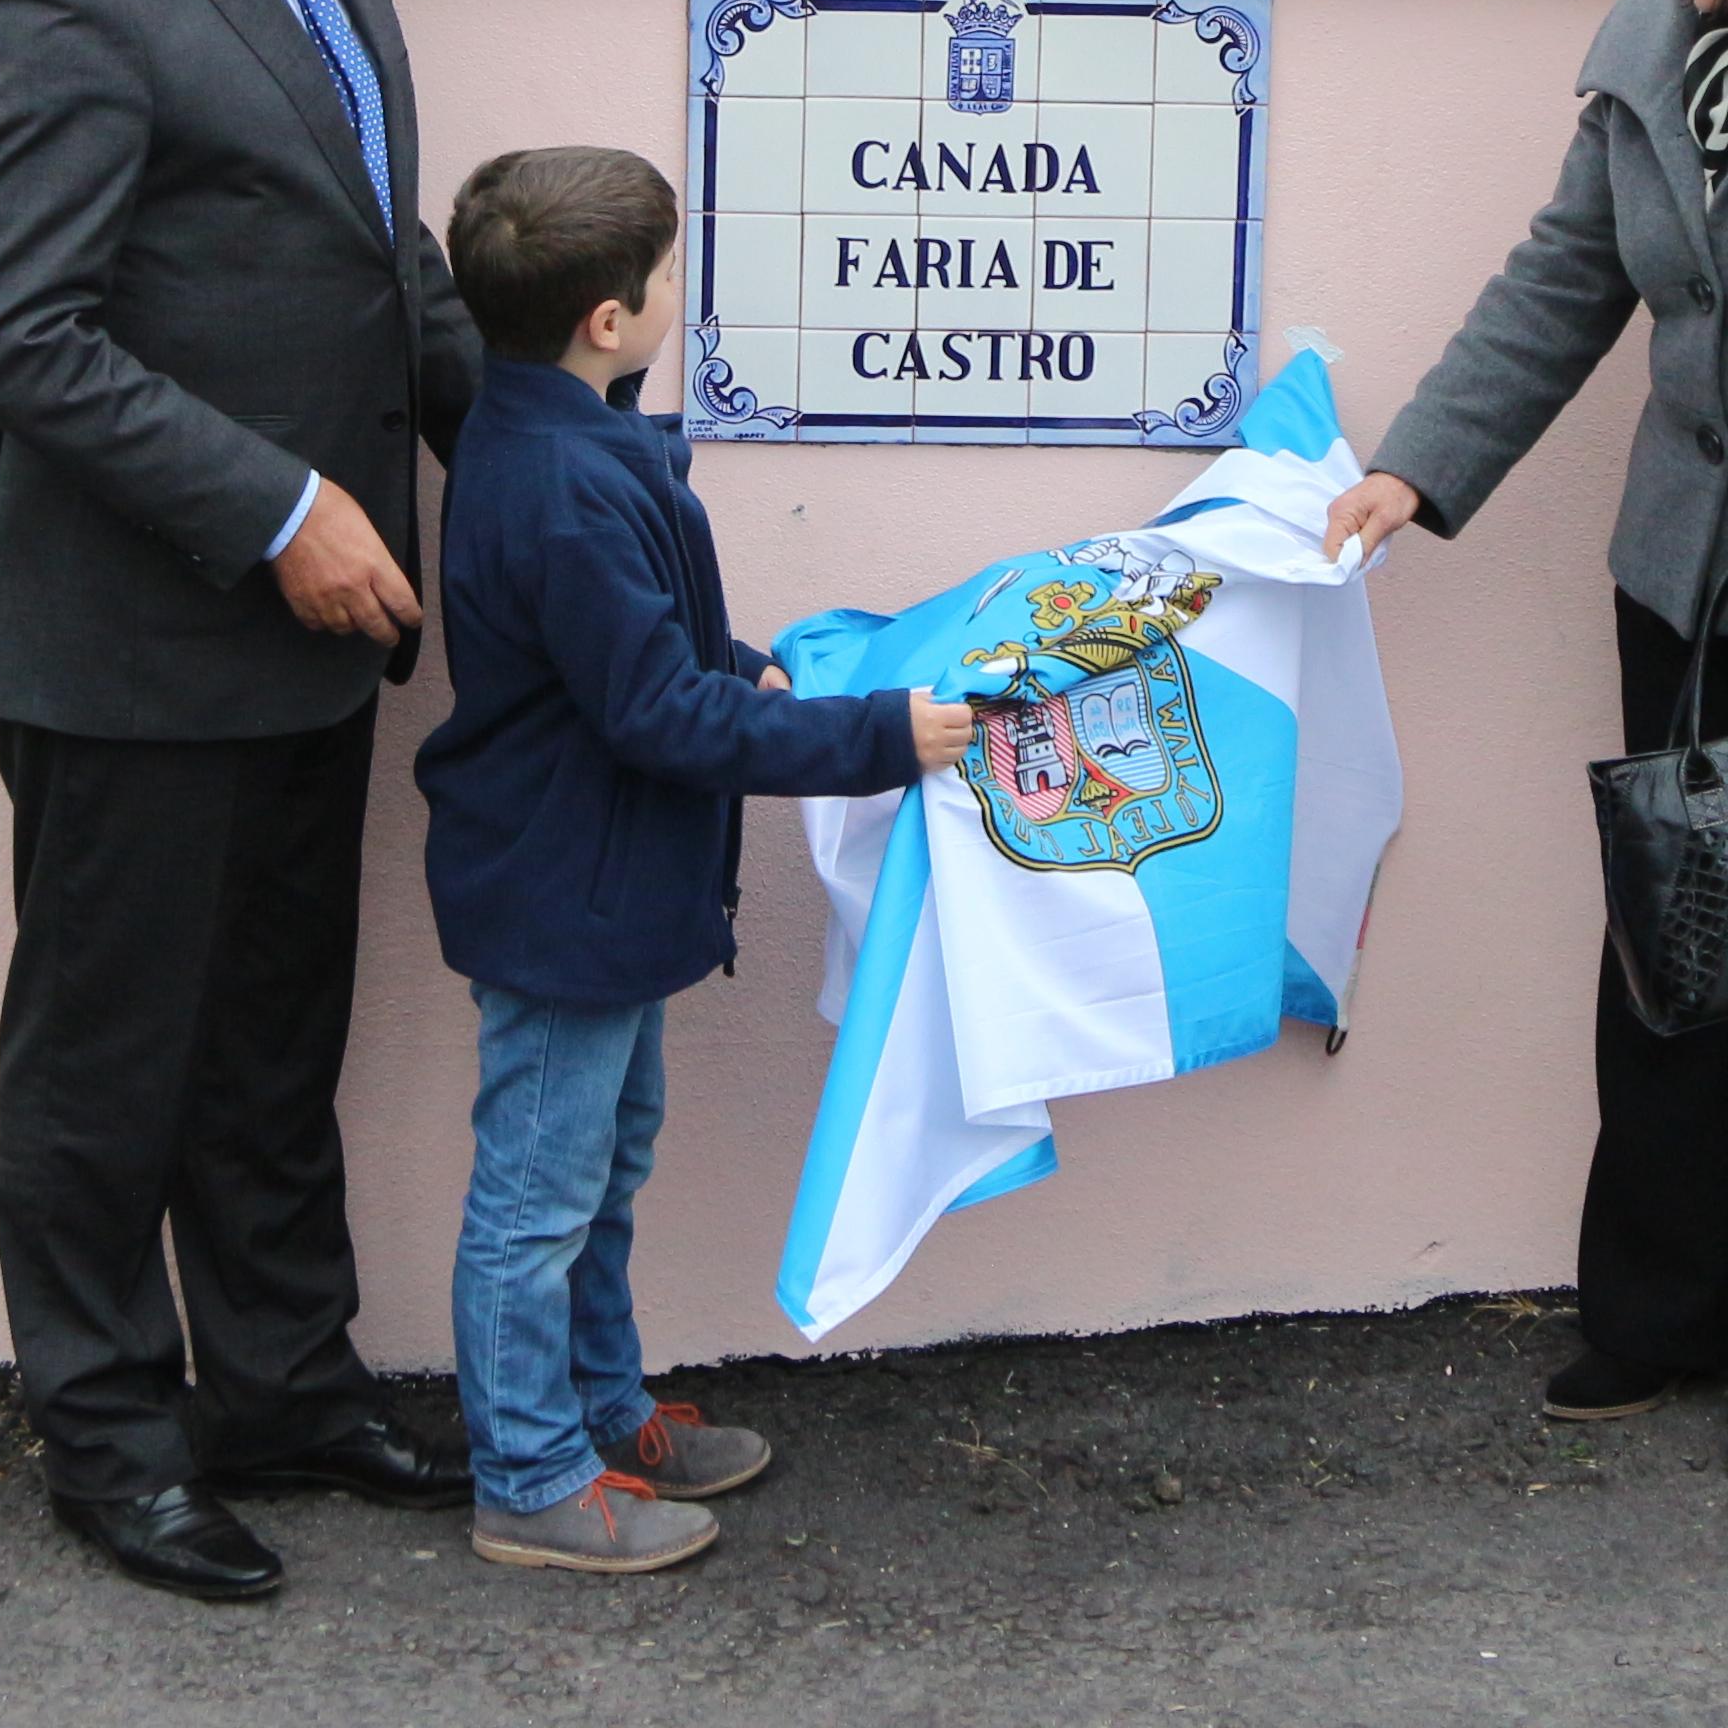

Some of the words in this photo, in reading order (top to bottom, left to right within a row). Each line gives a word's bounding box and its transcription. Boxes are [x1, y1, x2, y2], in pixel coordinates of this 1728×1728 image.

[851, 140, 1101, 194] CANADA
[834, 236, 1019, 290] FARIA
[1043, 239, 1115, 291] DE
[852, 331, 1096, 381] CASTRO
